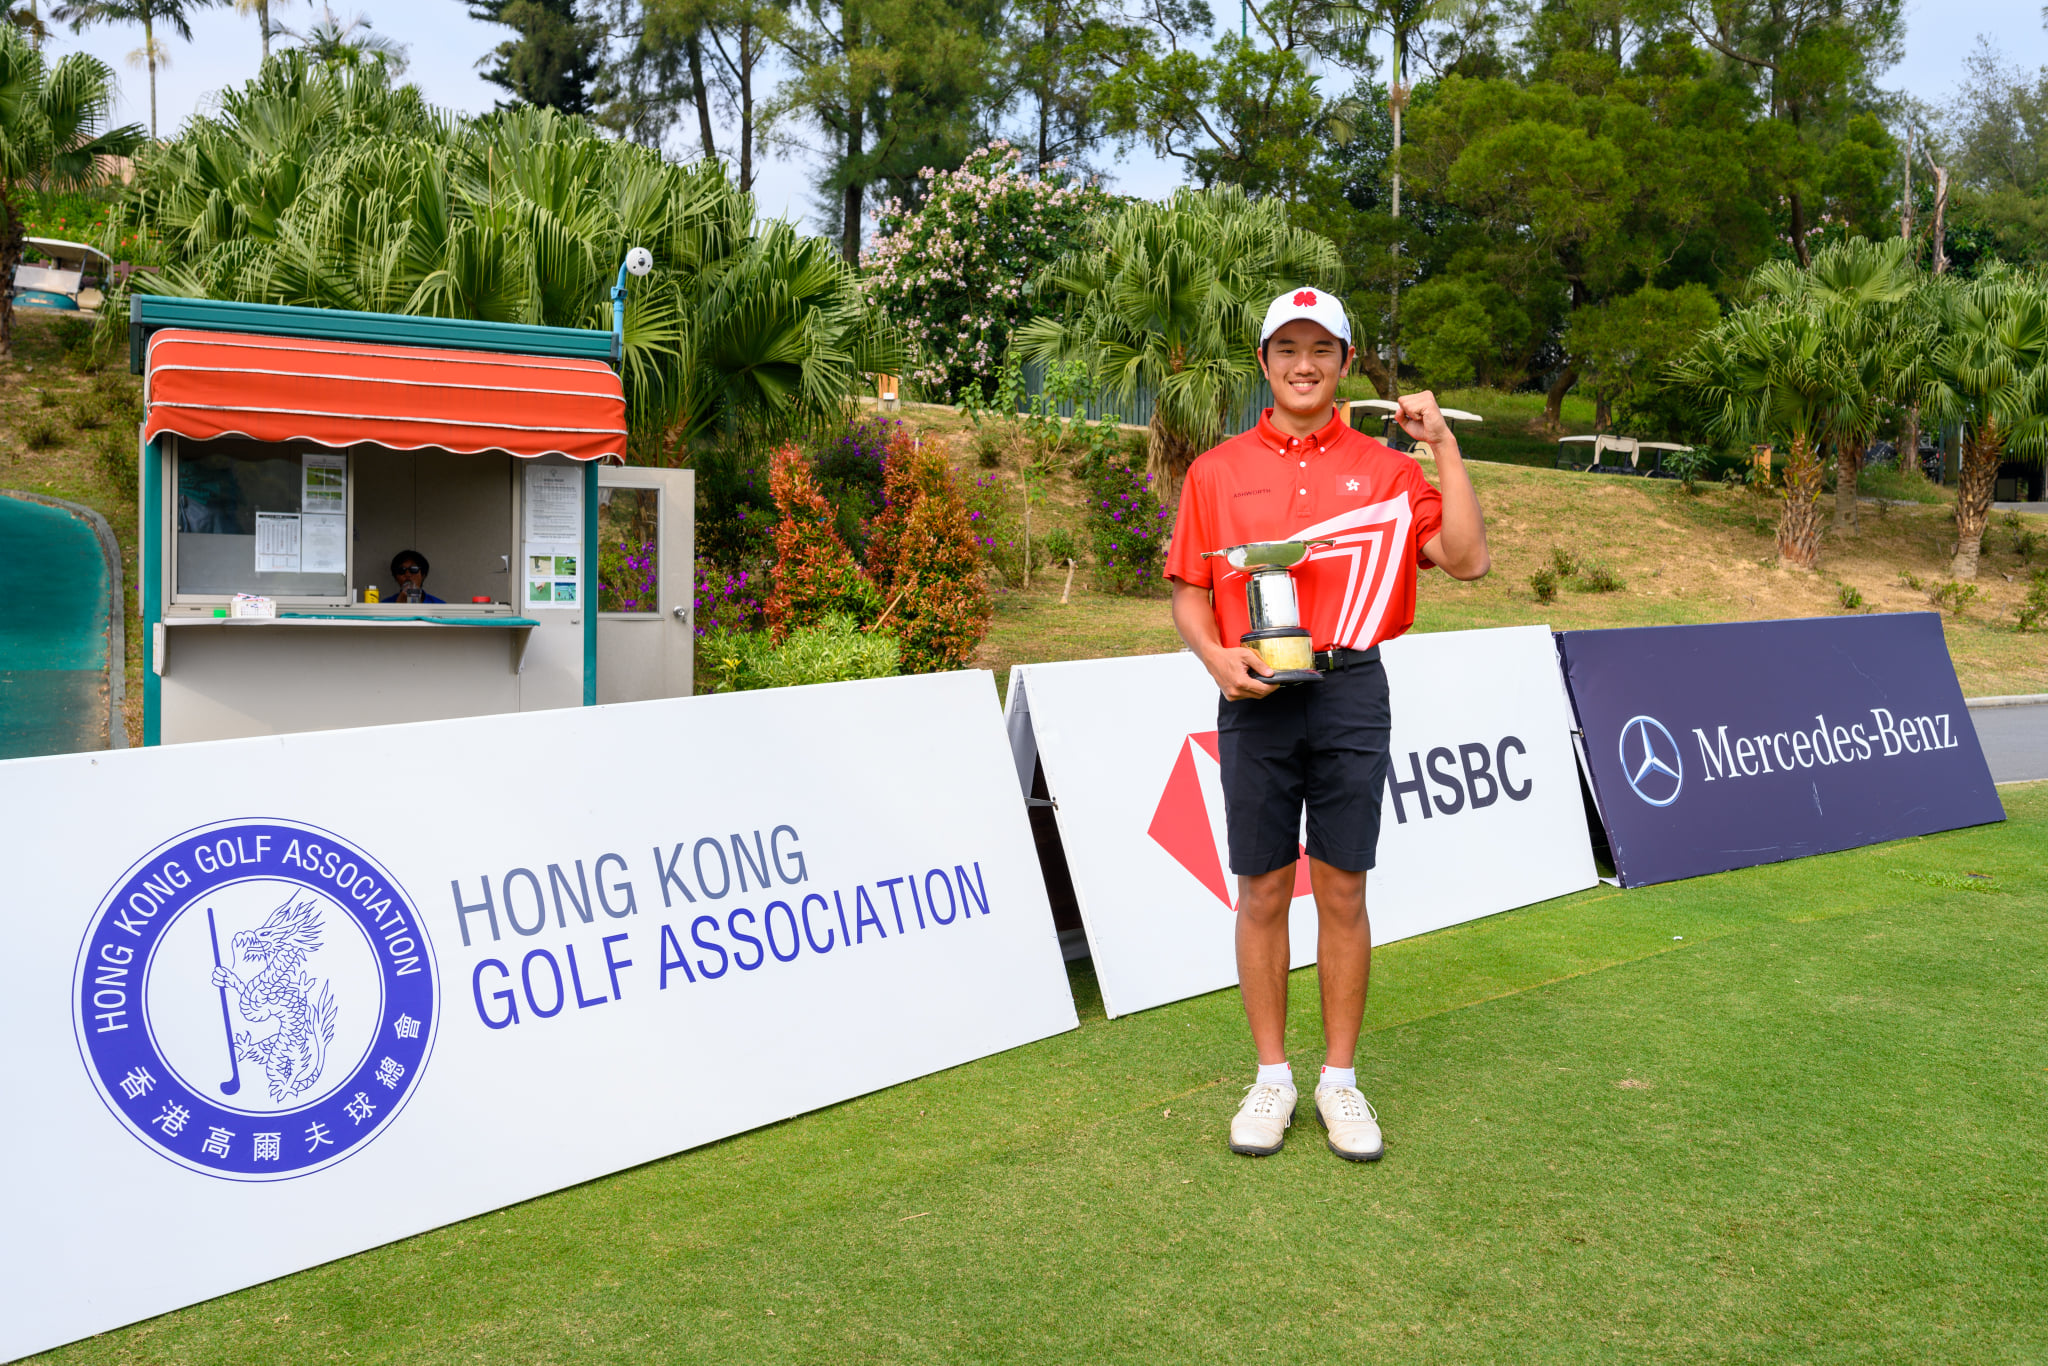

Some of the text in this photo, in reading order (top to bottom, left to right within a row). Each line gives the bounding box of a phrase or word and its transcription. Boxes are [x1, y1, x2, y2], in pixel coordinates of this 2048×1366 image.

[1233, 488, 1271, 498] ASHWORTH
[1387, 735, 1533, 825] HSBC
[1692, 708, 1959, 782] Mercedes-Benz
[92, 834, 422, 1034] HONG KONG GOLF ASSOCIATION
[450, 824, 809, 947] HONG KONG
[471, 860, 992, 1031] GOLF ASSOCIATION
[118, 1012, 423, 1162] 香港高爾夫球總會
